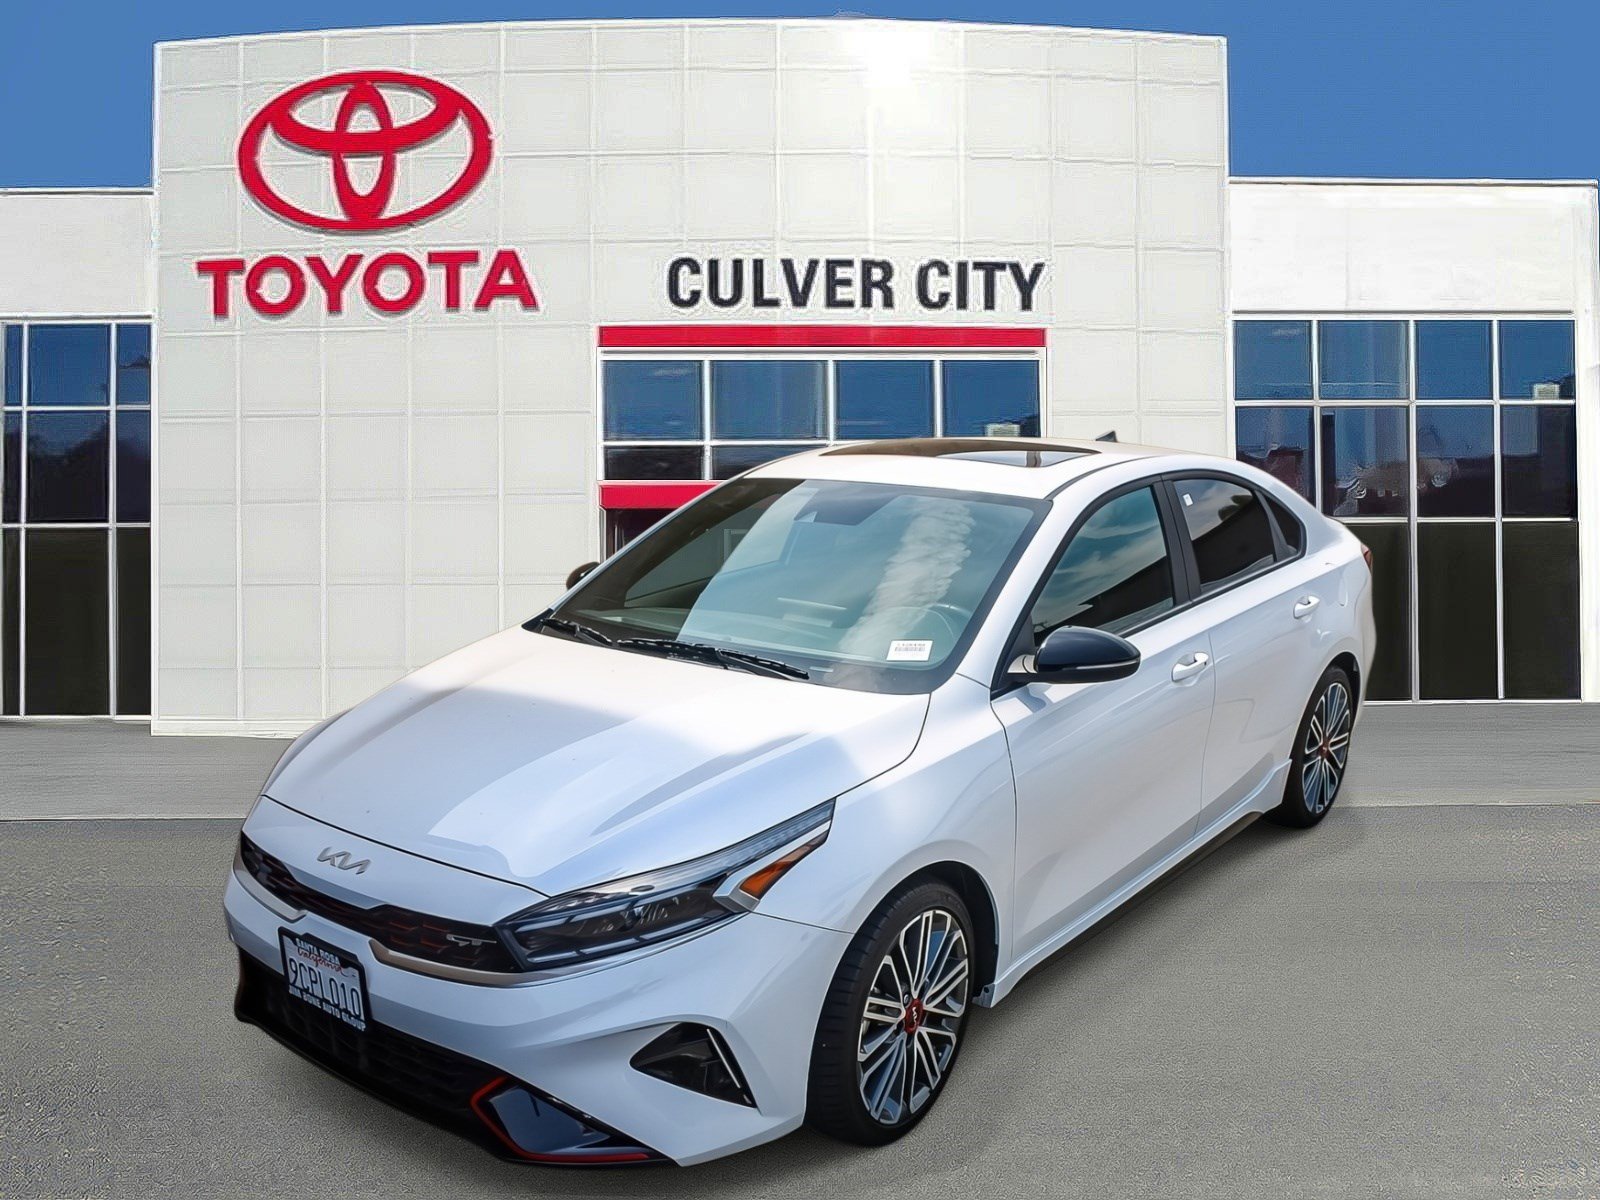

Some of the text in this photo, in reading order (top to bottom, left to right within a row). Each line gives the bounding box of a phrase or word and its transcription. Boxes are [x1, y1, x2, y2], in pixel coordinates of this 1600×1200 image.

[196, 250, 539, 318] TOYOTA
[668, 258, 1046, 311] CULVER CITY
[288, 957, 362, 1018] 9CPL010
